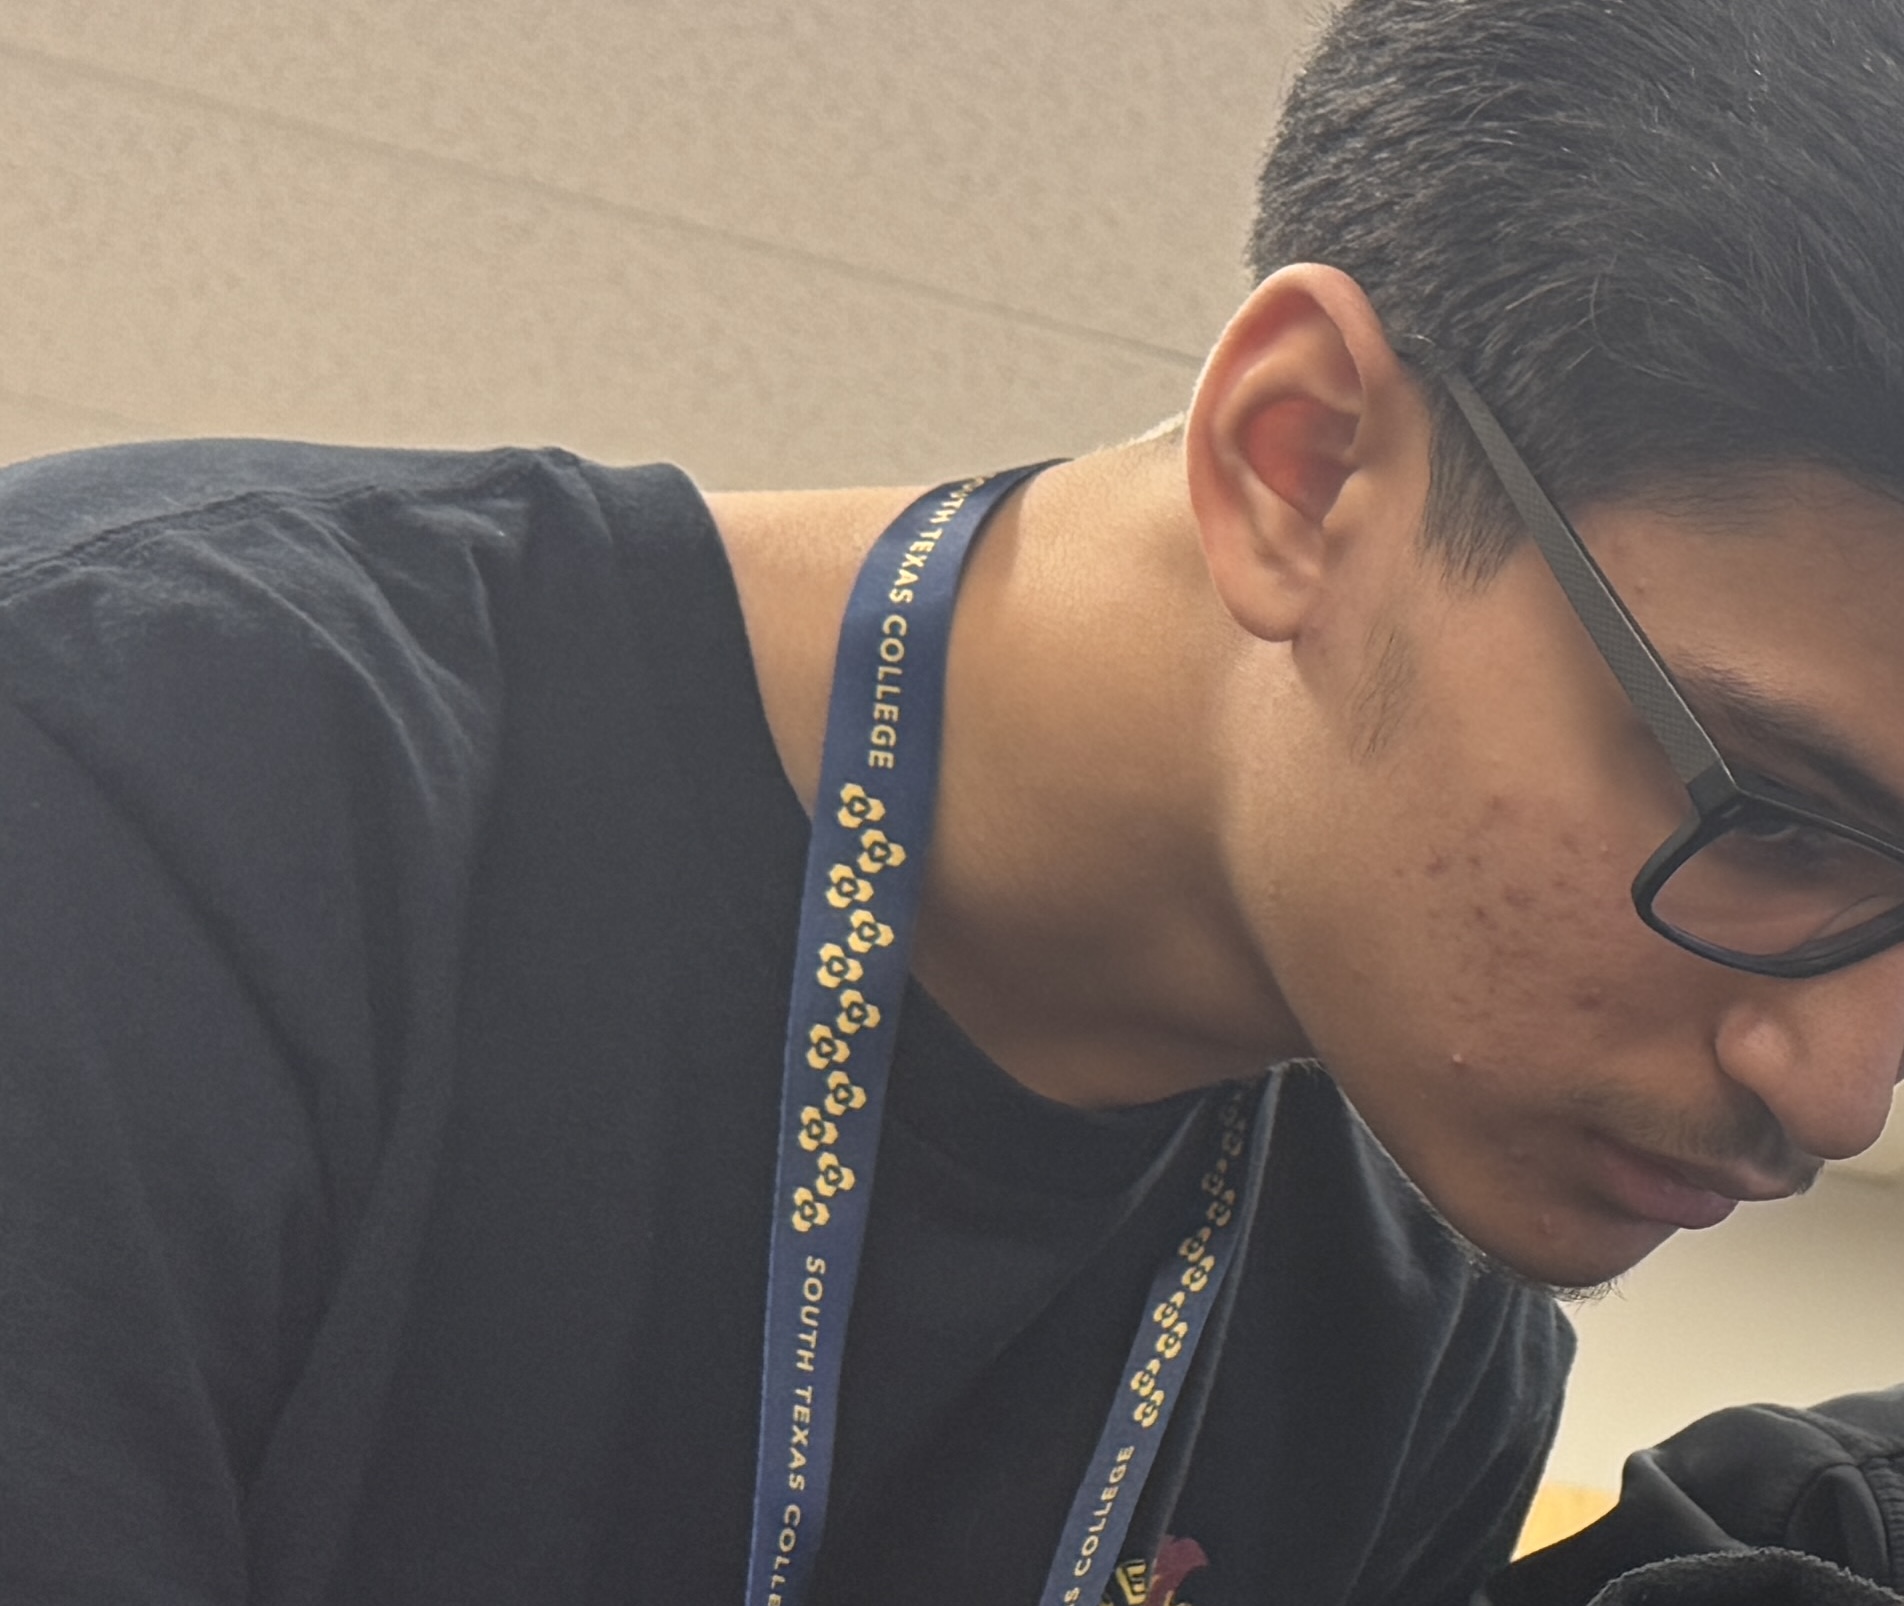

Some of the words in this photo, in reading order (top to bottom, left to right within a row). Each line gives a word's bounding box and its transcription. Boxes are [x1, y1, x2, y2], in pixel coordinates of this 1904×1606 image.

[889, 528, 943, 603] TEXAS
[868, 614, 908, 769] COLLEGE
[796, 1256, 826, 1371] SOUTH
[787, 1385, 813, 1491] TEXAS
[1074, 1446, 1135, 1577] COLLEGE
